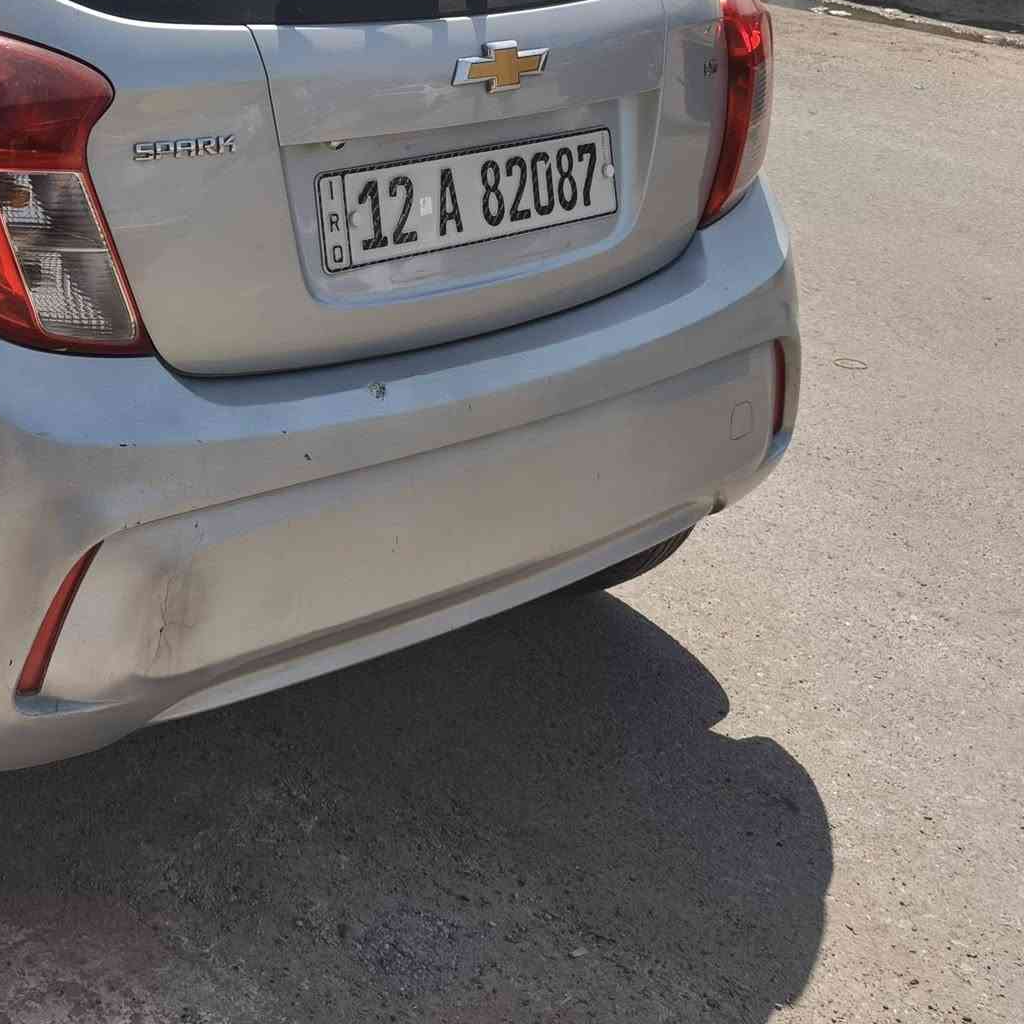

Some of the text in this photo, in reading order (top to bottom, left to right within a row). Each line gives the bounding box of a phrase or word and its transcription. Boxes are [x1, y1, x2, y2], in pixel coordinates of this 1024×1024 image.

[133, 135, 236, 161] SPARK
[357, 142, 597, 251] 12 A 82087
